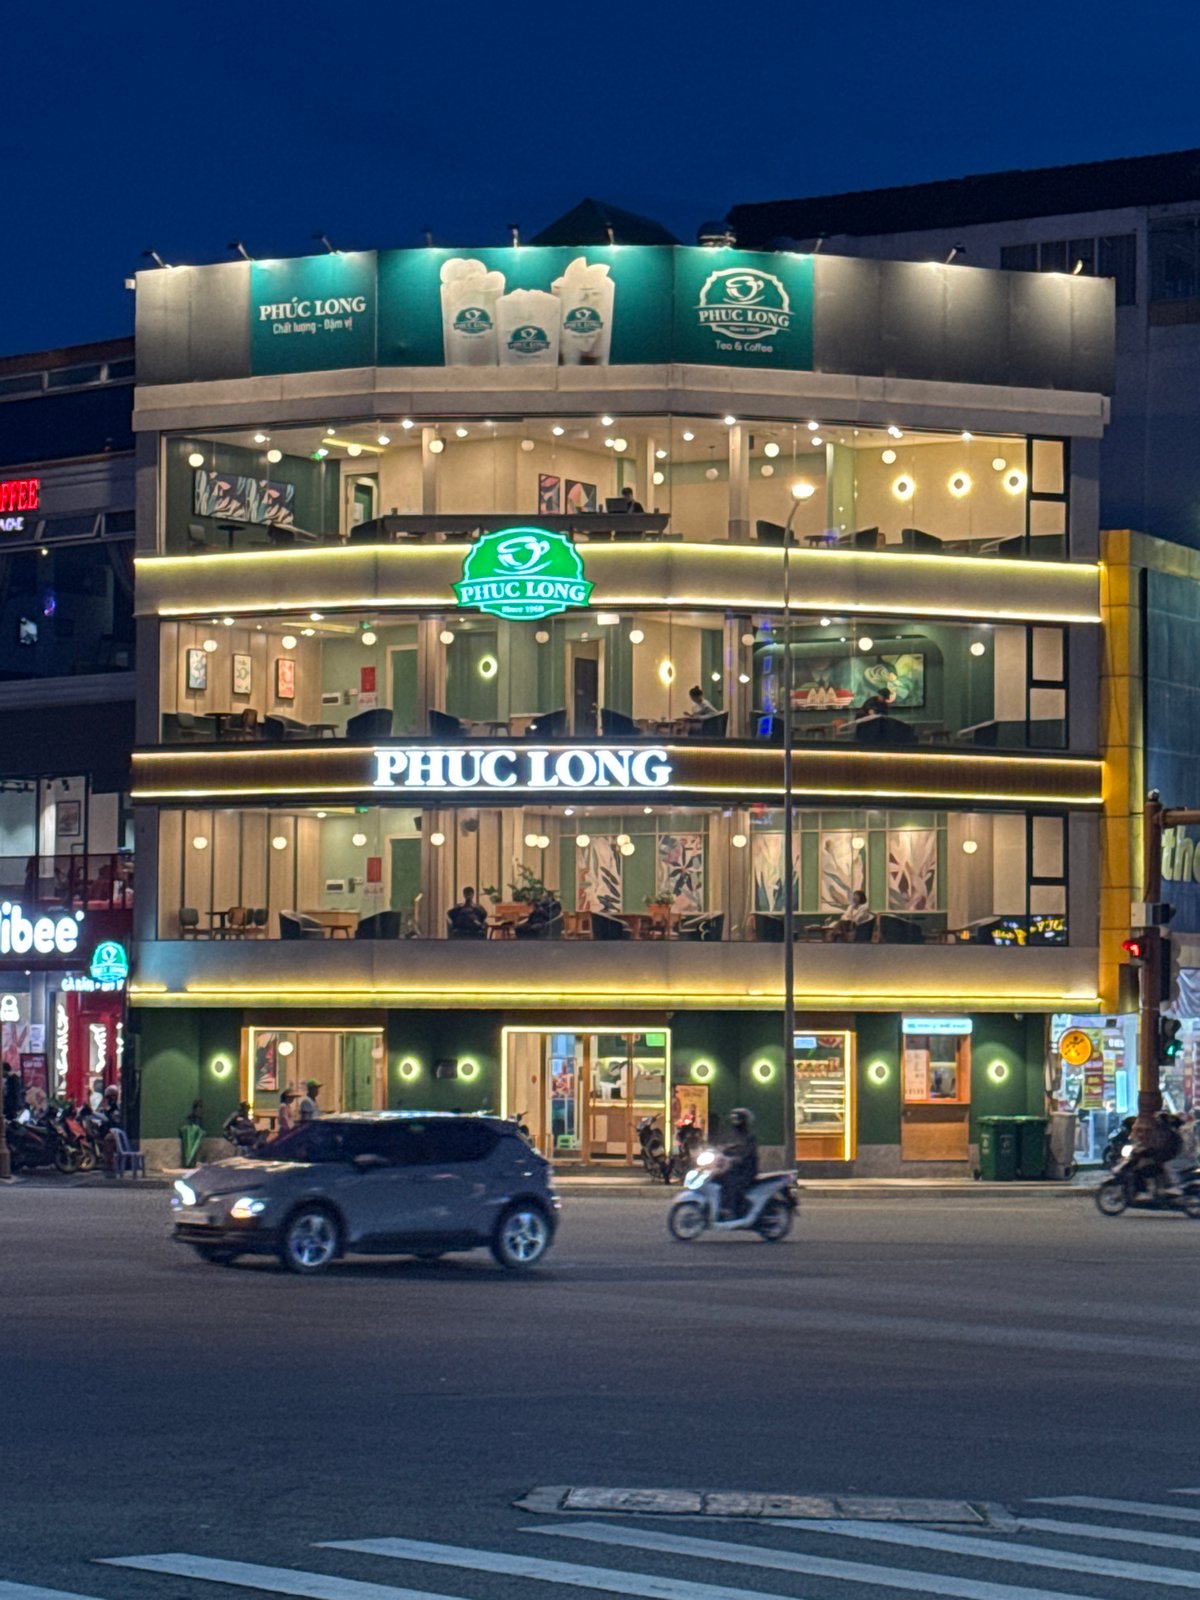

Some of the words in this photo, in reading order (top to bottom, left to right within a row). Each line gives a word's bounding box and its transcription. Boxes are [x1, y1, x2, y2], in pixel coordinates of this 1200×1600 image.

[259, 297, 311, 320] PHÚC
[314, 297, 366, 316] LONG
[700, 309, 743, 322] PHUC
[747, 310, 790, 327] LONG
[460, 582, 520, 602] PHUC
[525, 582, 585, 601] LONG
[373, 750, 517, 787] PHUC
[527, 750, 672, 787] LONG
[0, 901, 78, 954] ibee
